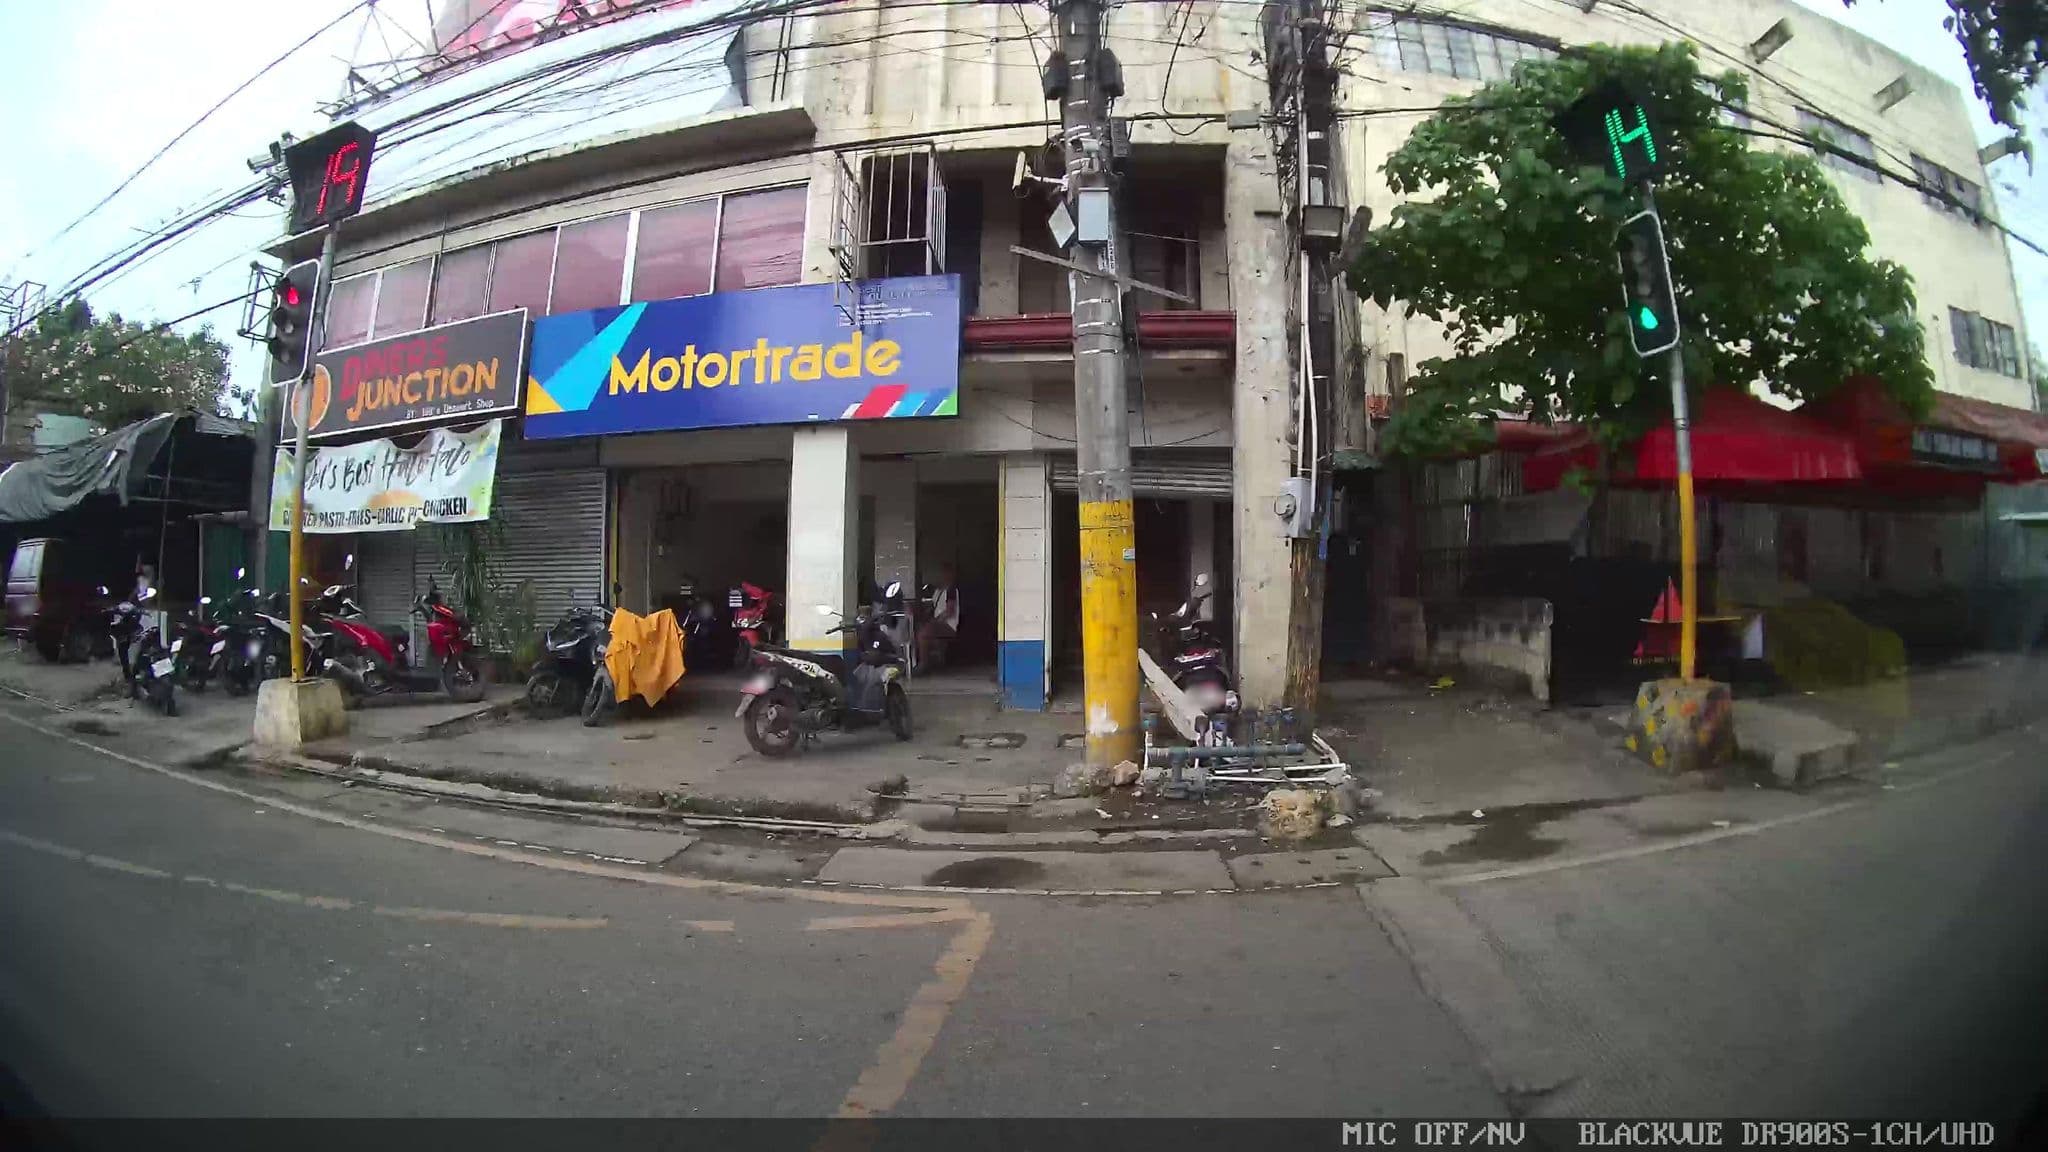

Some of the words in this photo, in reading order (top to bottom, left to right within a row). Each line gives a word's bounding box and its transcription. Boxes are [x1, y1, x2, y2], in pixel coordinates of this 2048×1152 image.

[1605, 105, 1656, 178] 14
[340, 336, 449, 399] DINERS
[347, 357, 498, 421] JUNCTION
[608, 331, 902, 395] Motortrade
[476, 398, 494, 409] Shop
[344, 455, 376, 492] Best
